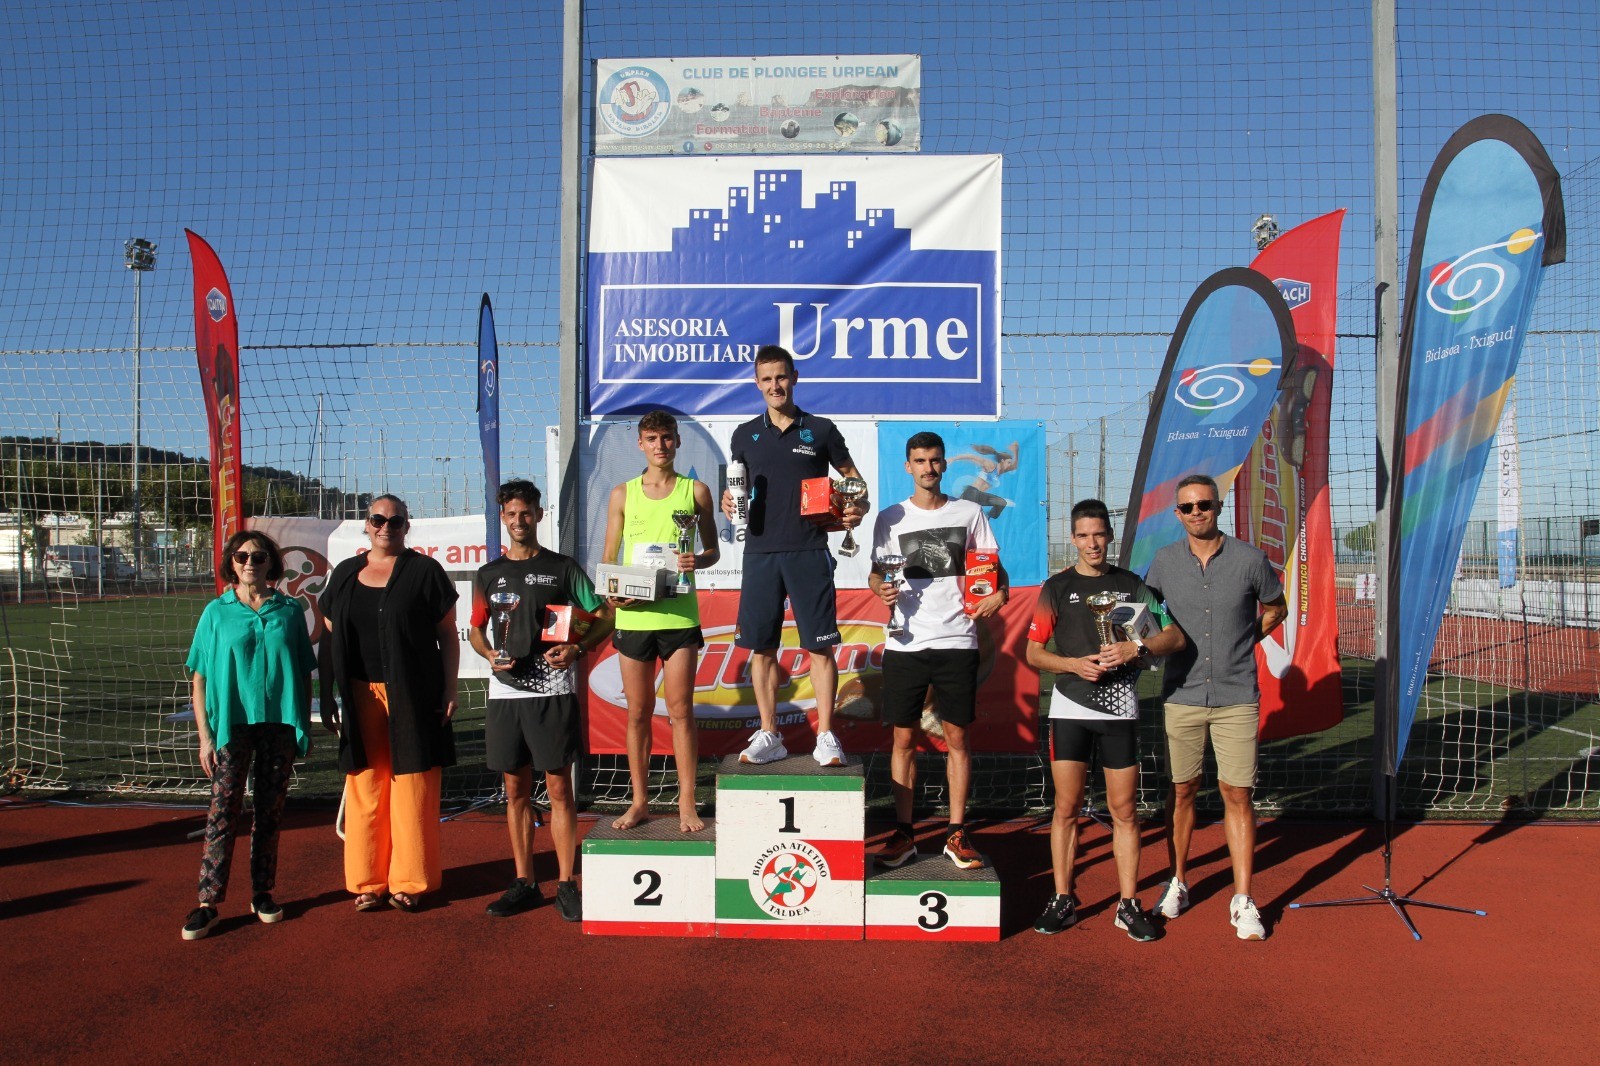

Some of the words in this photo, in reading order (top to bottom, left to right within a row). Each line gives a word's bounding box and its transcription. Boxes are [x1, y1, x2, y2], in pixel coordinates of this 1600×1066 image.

[683, 67, 723, 80] CLUB
[728, 67, 750, 79] DE
[754, 66, 827, 79] PLONGEE
[832, 65, 899, 79] URPEAN
[814, 88, 897, 102] Exploration
[696, 123, 769, 136] Formation
[1282, 286, 1308, 302] ACH
[614, 317, 730, 338] ASESORIA
[773, 303, 968, 360] Urme
[613, 343, 760, 363] INMOBILIARI
[1425, 344, 1460, 364] Bidasoa
[1300, 564, 1308, 612] AUTÉNTICO
[778, 797, 801, 834] 1
[752, 842, 787, 876] BIDASOA
[789, 842, 828, 878] ATLETIKO
[633, 869, 663, 906] 2
[769, 904, 810, 917] TALDEA
[917, 892, 949, 930] 3
